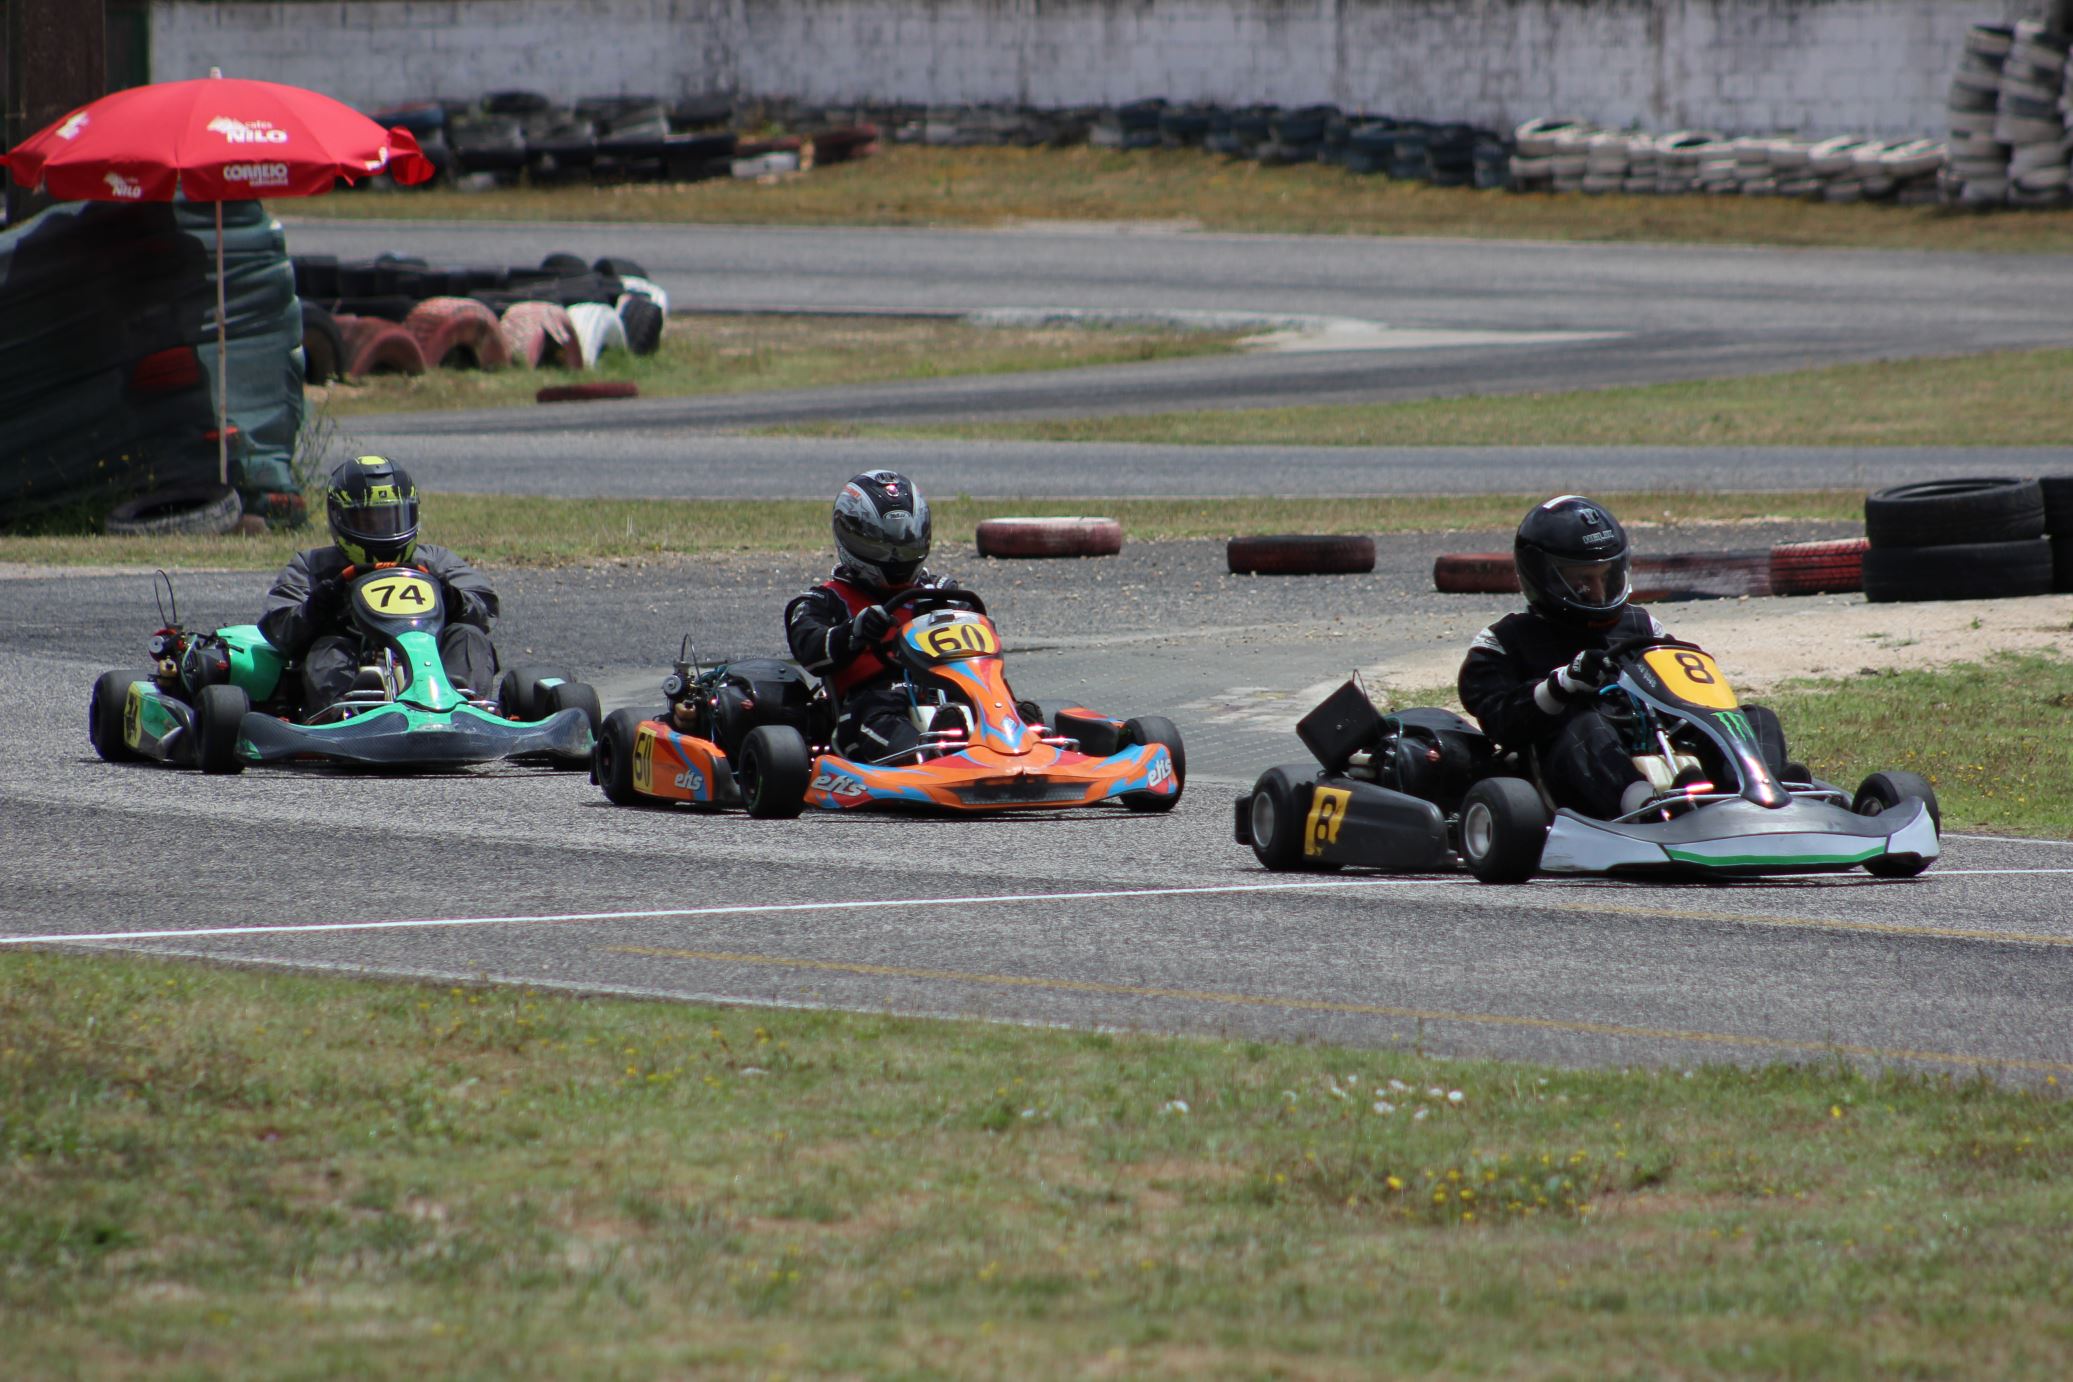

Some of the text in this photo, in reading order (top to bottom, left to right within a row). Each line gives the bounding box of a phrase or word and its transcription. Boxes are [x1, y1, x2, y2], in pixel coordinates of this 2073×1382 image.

[226, 129, 288, 144] NILO
[370, 584, 426, 608] 74
[928, 624, 985, 653] 60
[1674, 652, 1715, 684] 8
[635, 732, 652, 787] 60
[1314, 794, 1337, 848] 8
